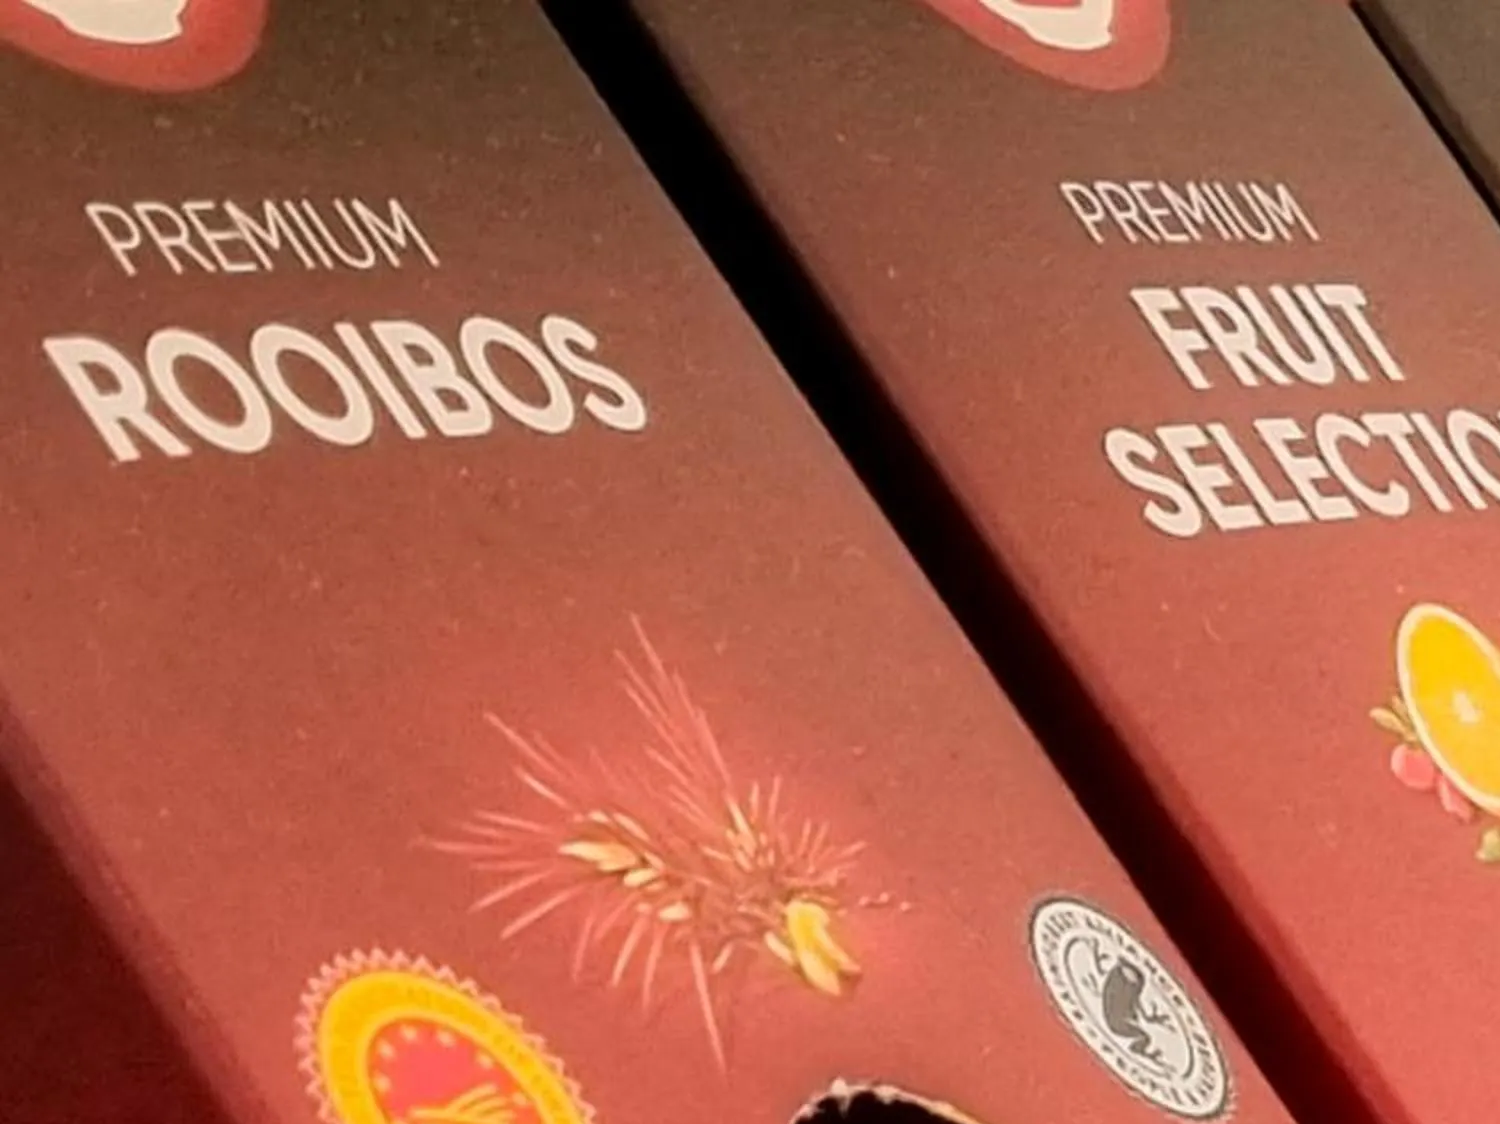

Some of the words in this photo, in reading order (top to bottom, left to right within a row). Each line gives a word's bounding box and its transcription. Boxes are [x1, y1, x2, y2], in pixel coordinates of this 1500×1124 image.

[84, 199, 440, 275] PREMIUM
[1060, 181, 1320, 245] PREMIUM
[1130, 285, 1405, 389] FRUIT
[43, 314, 647, 462] ROOIBOS
